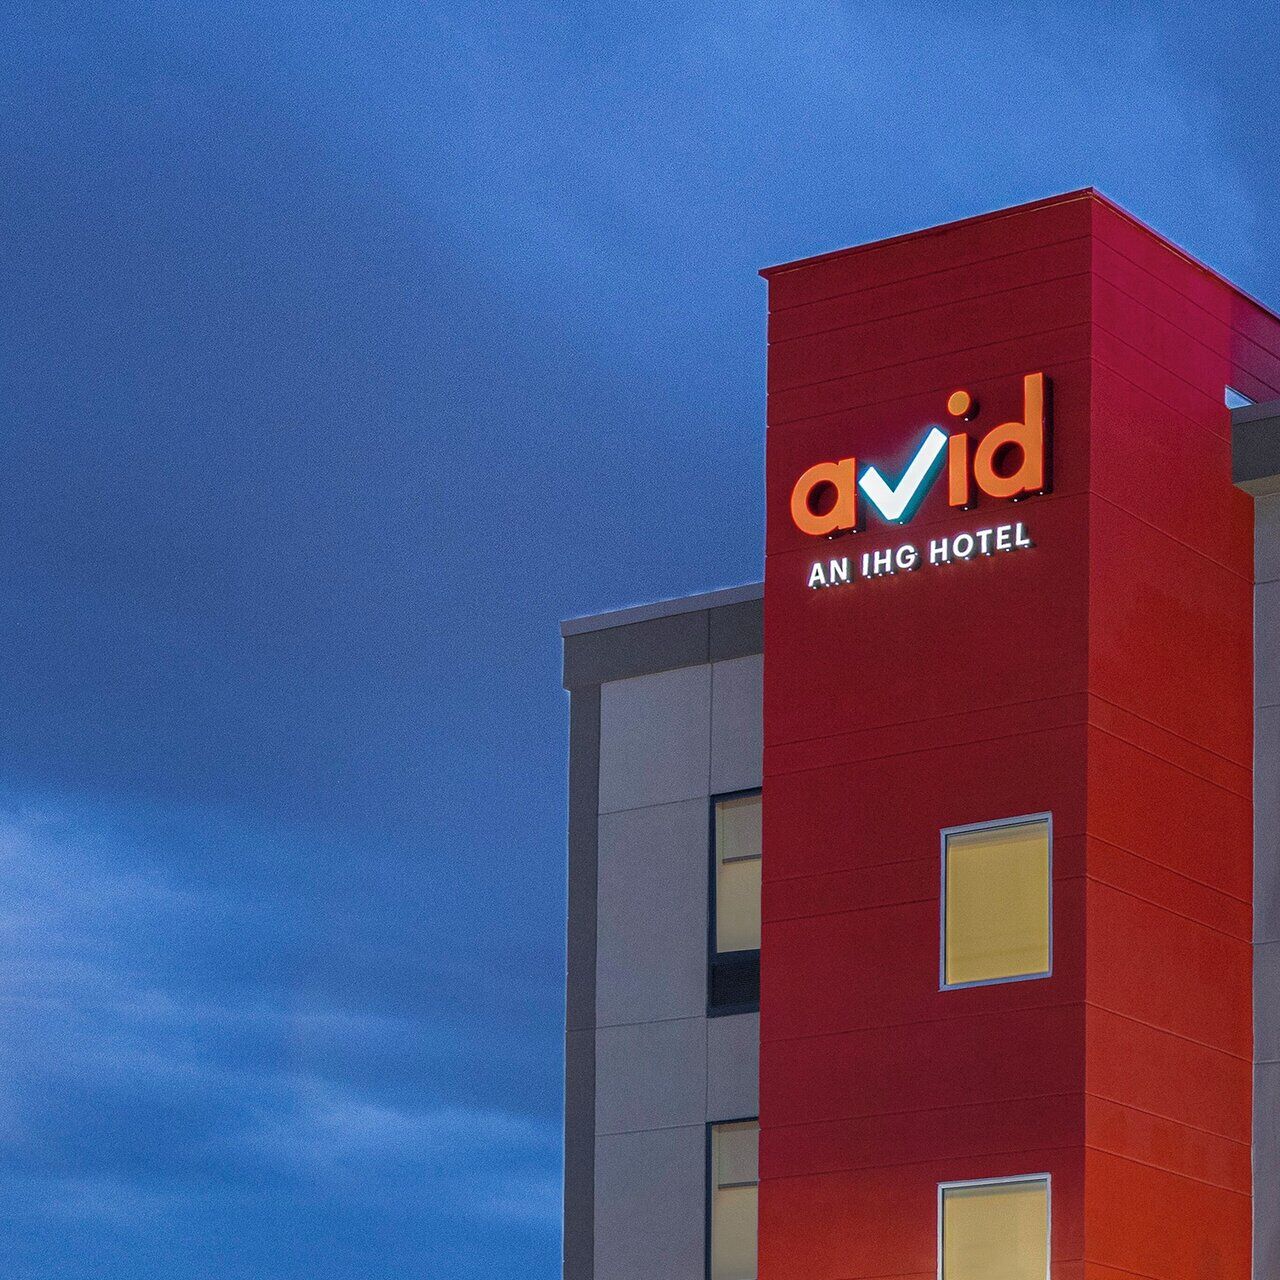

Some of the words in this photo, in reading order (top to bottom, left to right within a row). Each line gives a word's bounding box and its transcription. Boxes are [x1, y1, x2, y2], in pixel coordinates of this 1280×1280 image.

[790, 372, 1044, 536] avid
[808, 557, 849, 588] AN
[862, 545, 919, 577] IHG
[930, 523, 1031, 564] HOTEL
